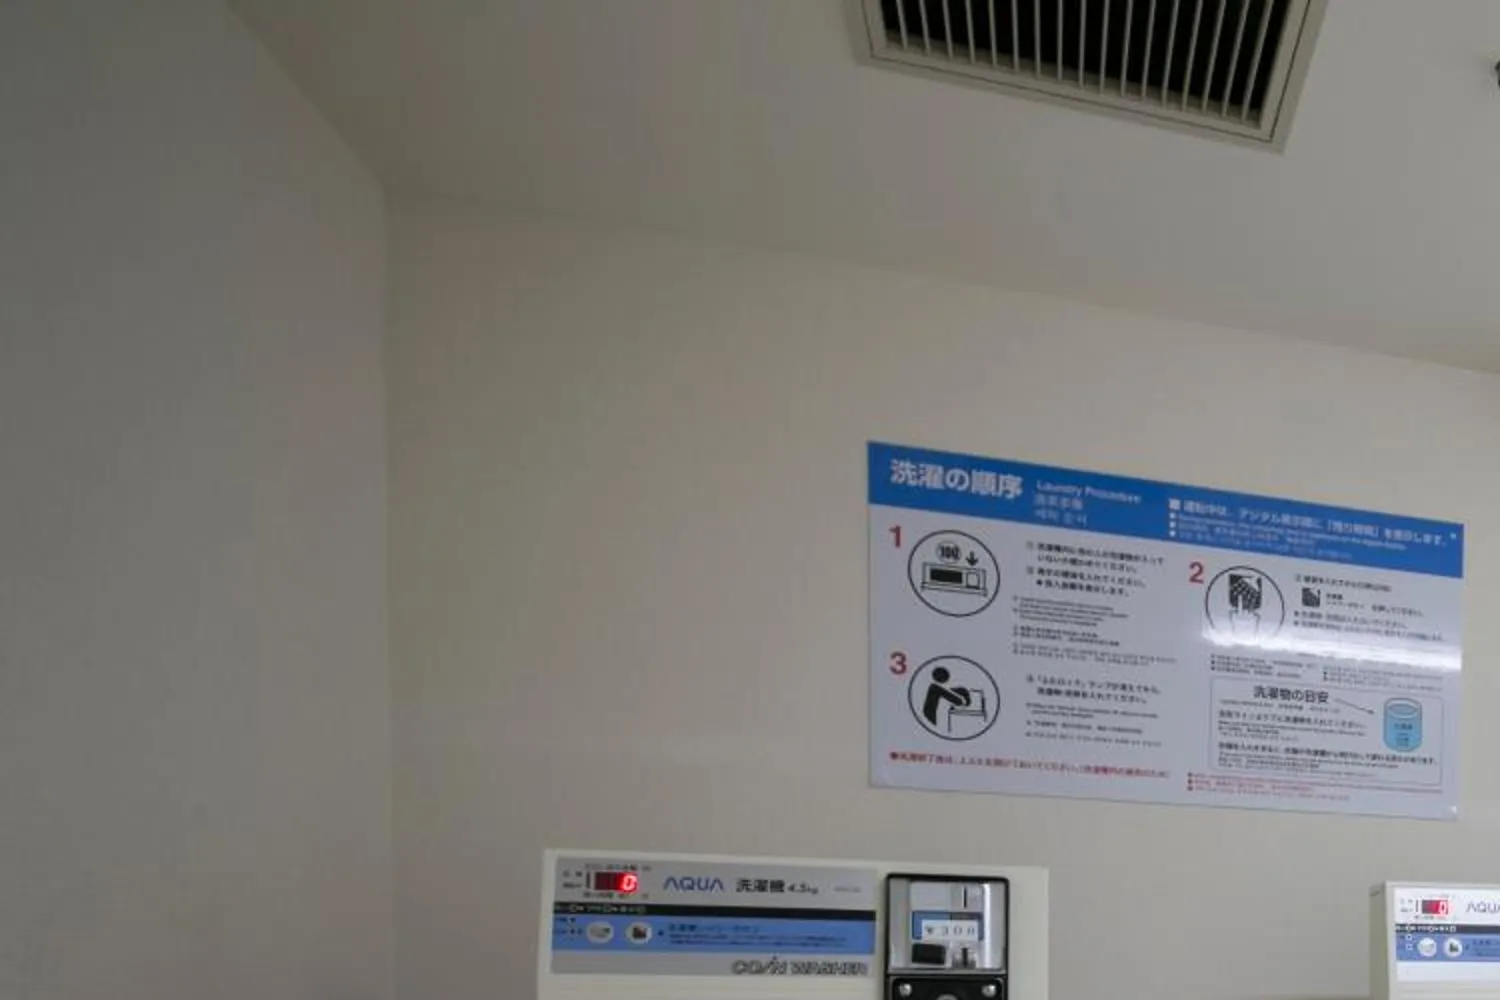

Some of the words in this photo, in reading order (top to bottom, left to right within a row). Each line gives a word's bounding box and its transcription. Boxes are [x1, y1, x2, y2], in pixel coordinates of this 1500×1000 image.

[891, 458, 1022, 498] 洗濯の順序
[889, 525, 901, 548] 1
[1189, 562, 1204, 584] 2
[889, 652, 907, 675] 3
[1253, 685, 1329, 704] 洗濯物の目安
[663, 876, 724, 892] AQUA
[736, 878, 785, 893] 洗濯機
